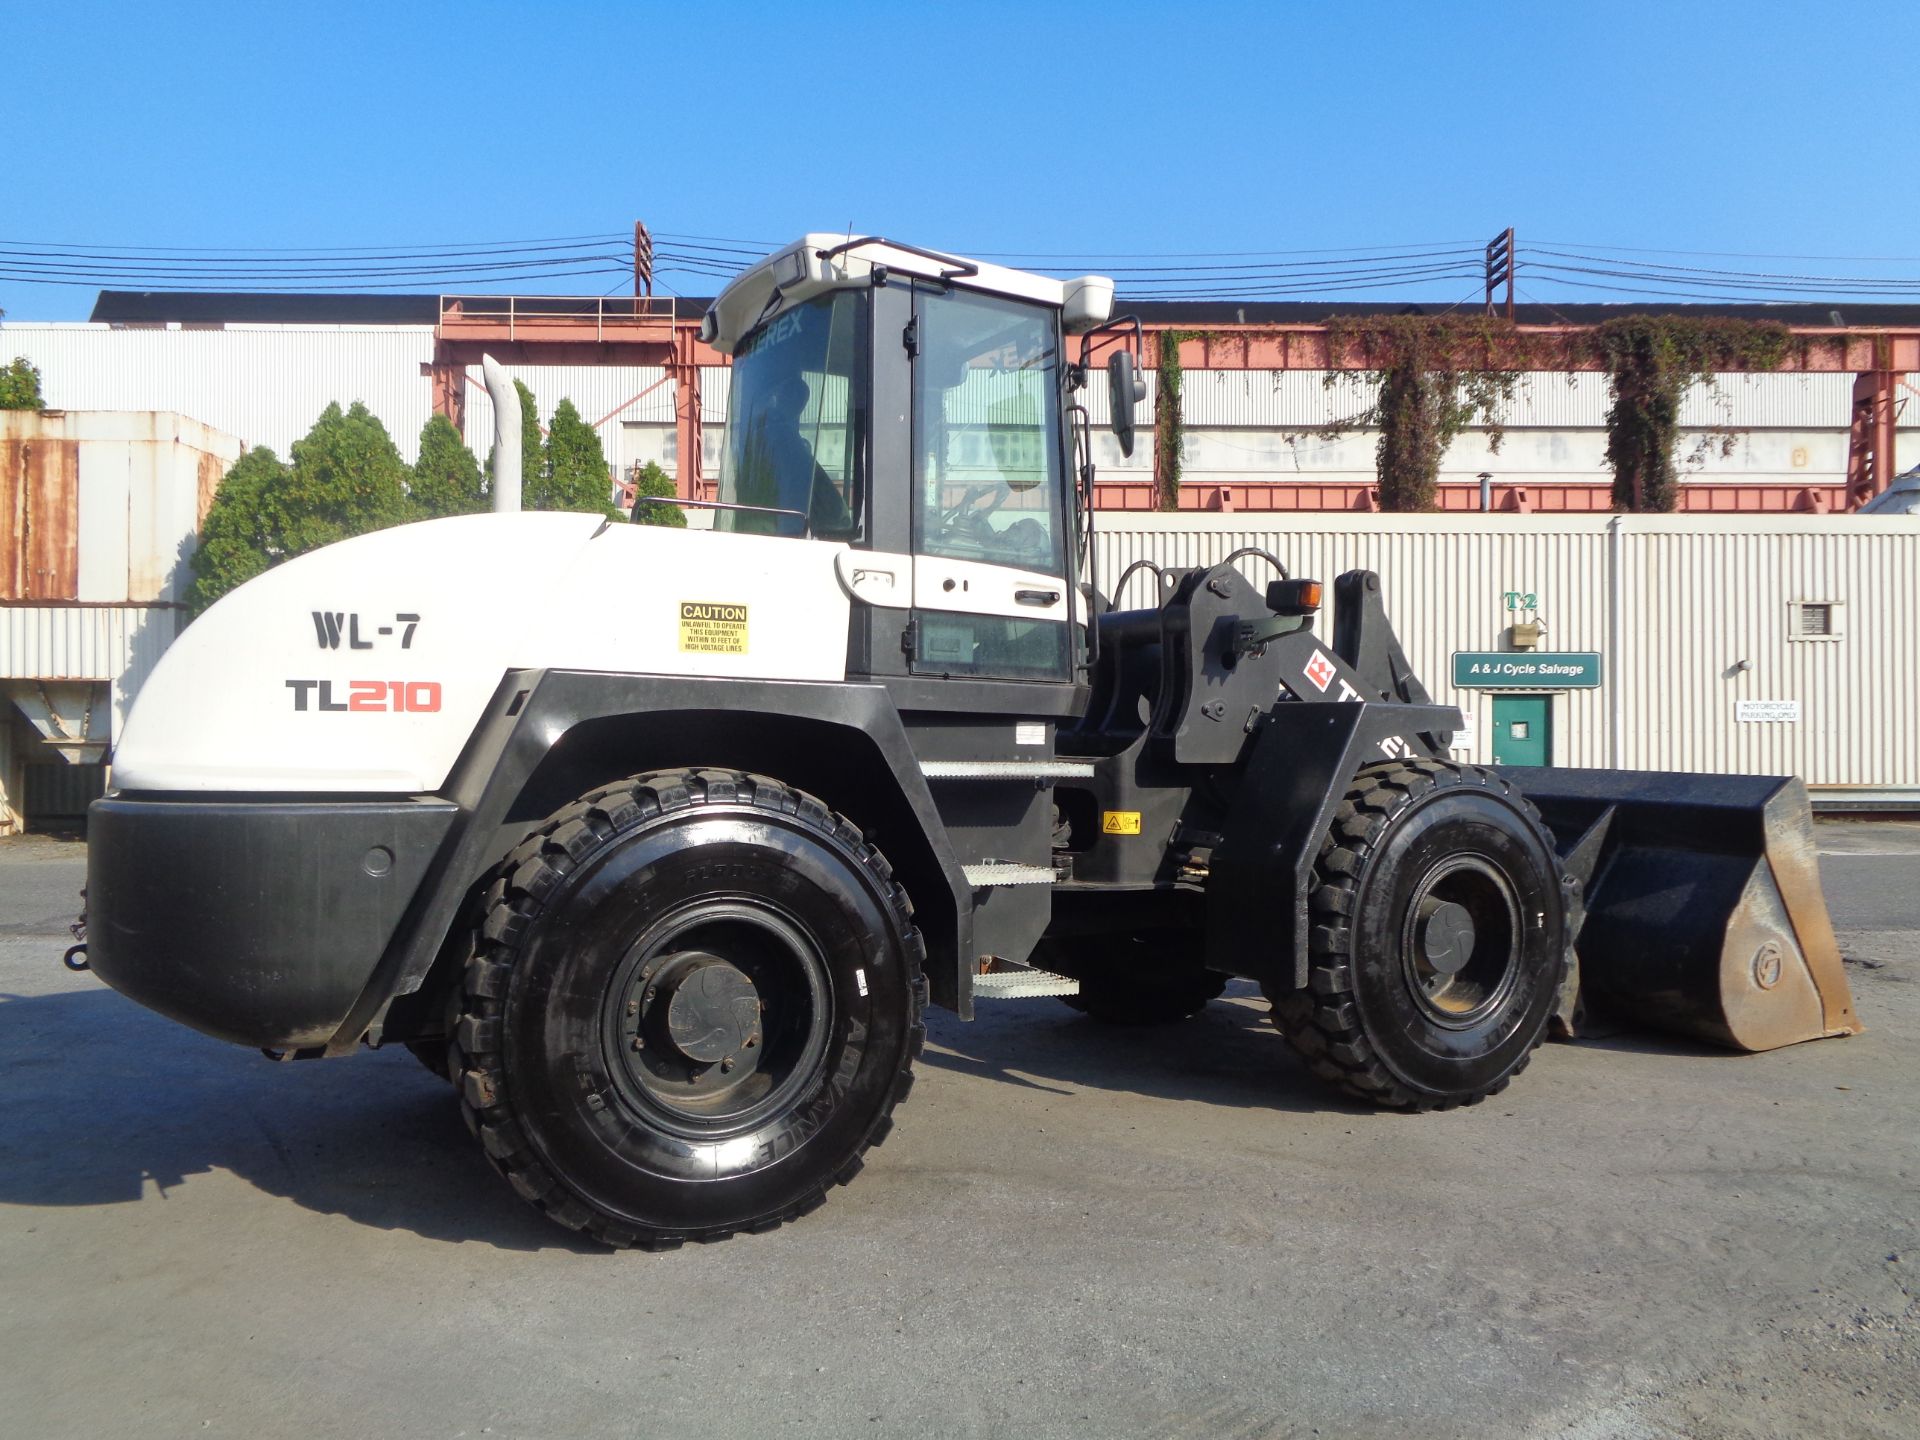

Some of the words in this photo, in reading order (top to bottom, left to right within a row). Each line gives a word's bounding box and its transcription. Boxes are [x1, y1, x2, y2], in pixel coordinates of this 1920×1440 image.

[683, 605, 745, 620] CAUTION
[312, 611, 421, 650] WL-7
[681, 621, 711, 629] UNLAWFUL
[713, 621, 720, 629] TO
[721, 622, 746, 630] OPERATE
[704, 629, 738, 637] EQUIPMENT
[687, 635, 709, 644] WITHIN
[710, 636, 717, 644] 10
[717, 637, 731, 645] FEET
[732, 637, 740, 645] OF
[685, 643, 699, 651] HIGH
[700, 644, 724, 652] VOLTAGE
[725, 644, 742, 652] LINES
[1470, 664, 1480, 674] A
[1482, 664, 1491, 674] &
[1493, 664, 1501, 674] J
[1503, 663, 1536, 677] Cycle
[1539, 663, 1584, 677] Salvage
[285, 679, 442, 713] TL210
[1741, 711, 1775, 719] PARKING
[1778, 711, 1797, 719] ONLY
[757, 1016, 867, 1164] ADVANCE
